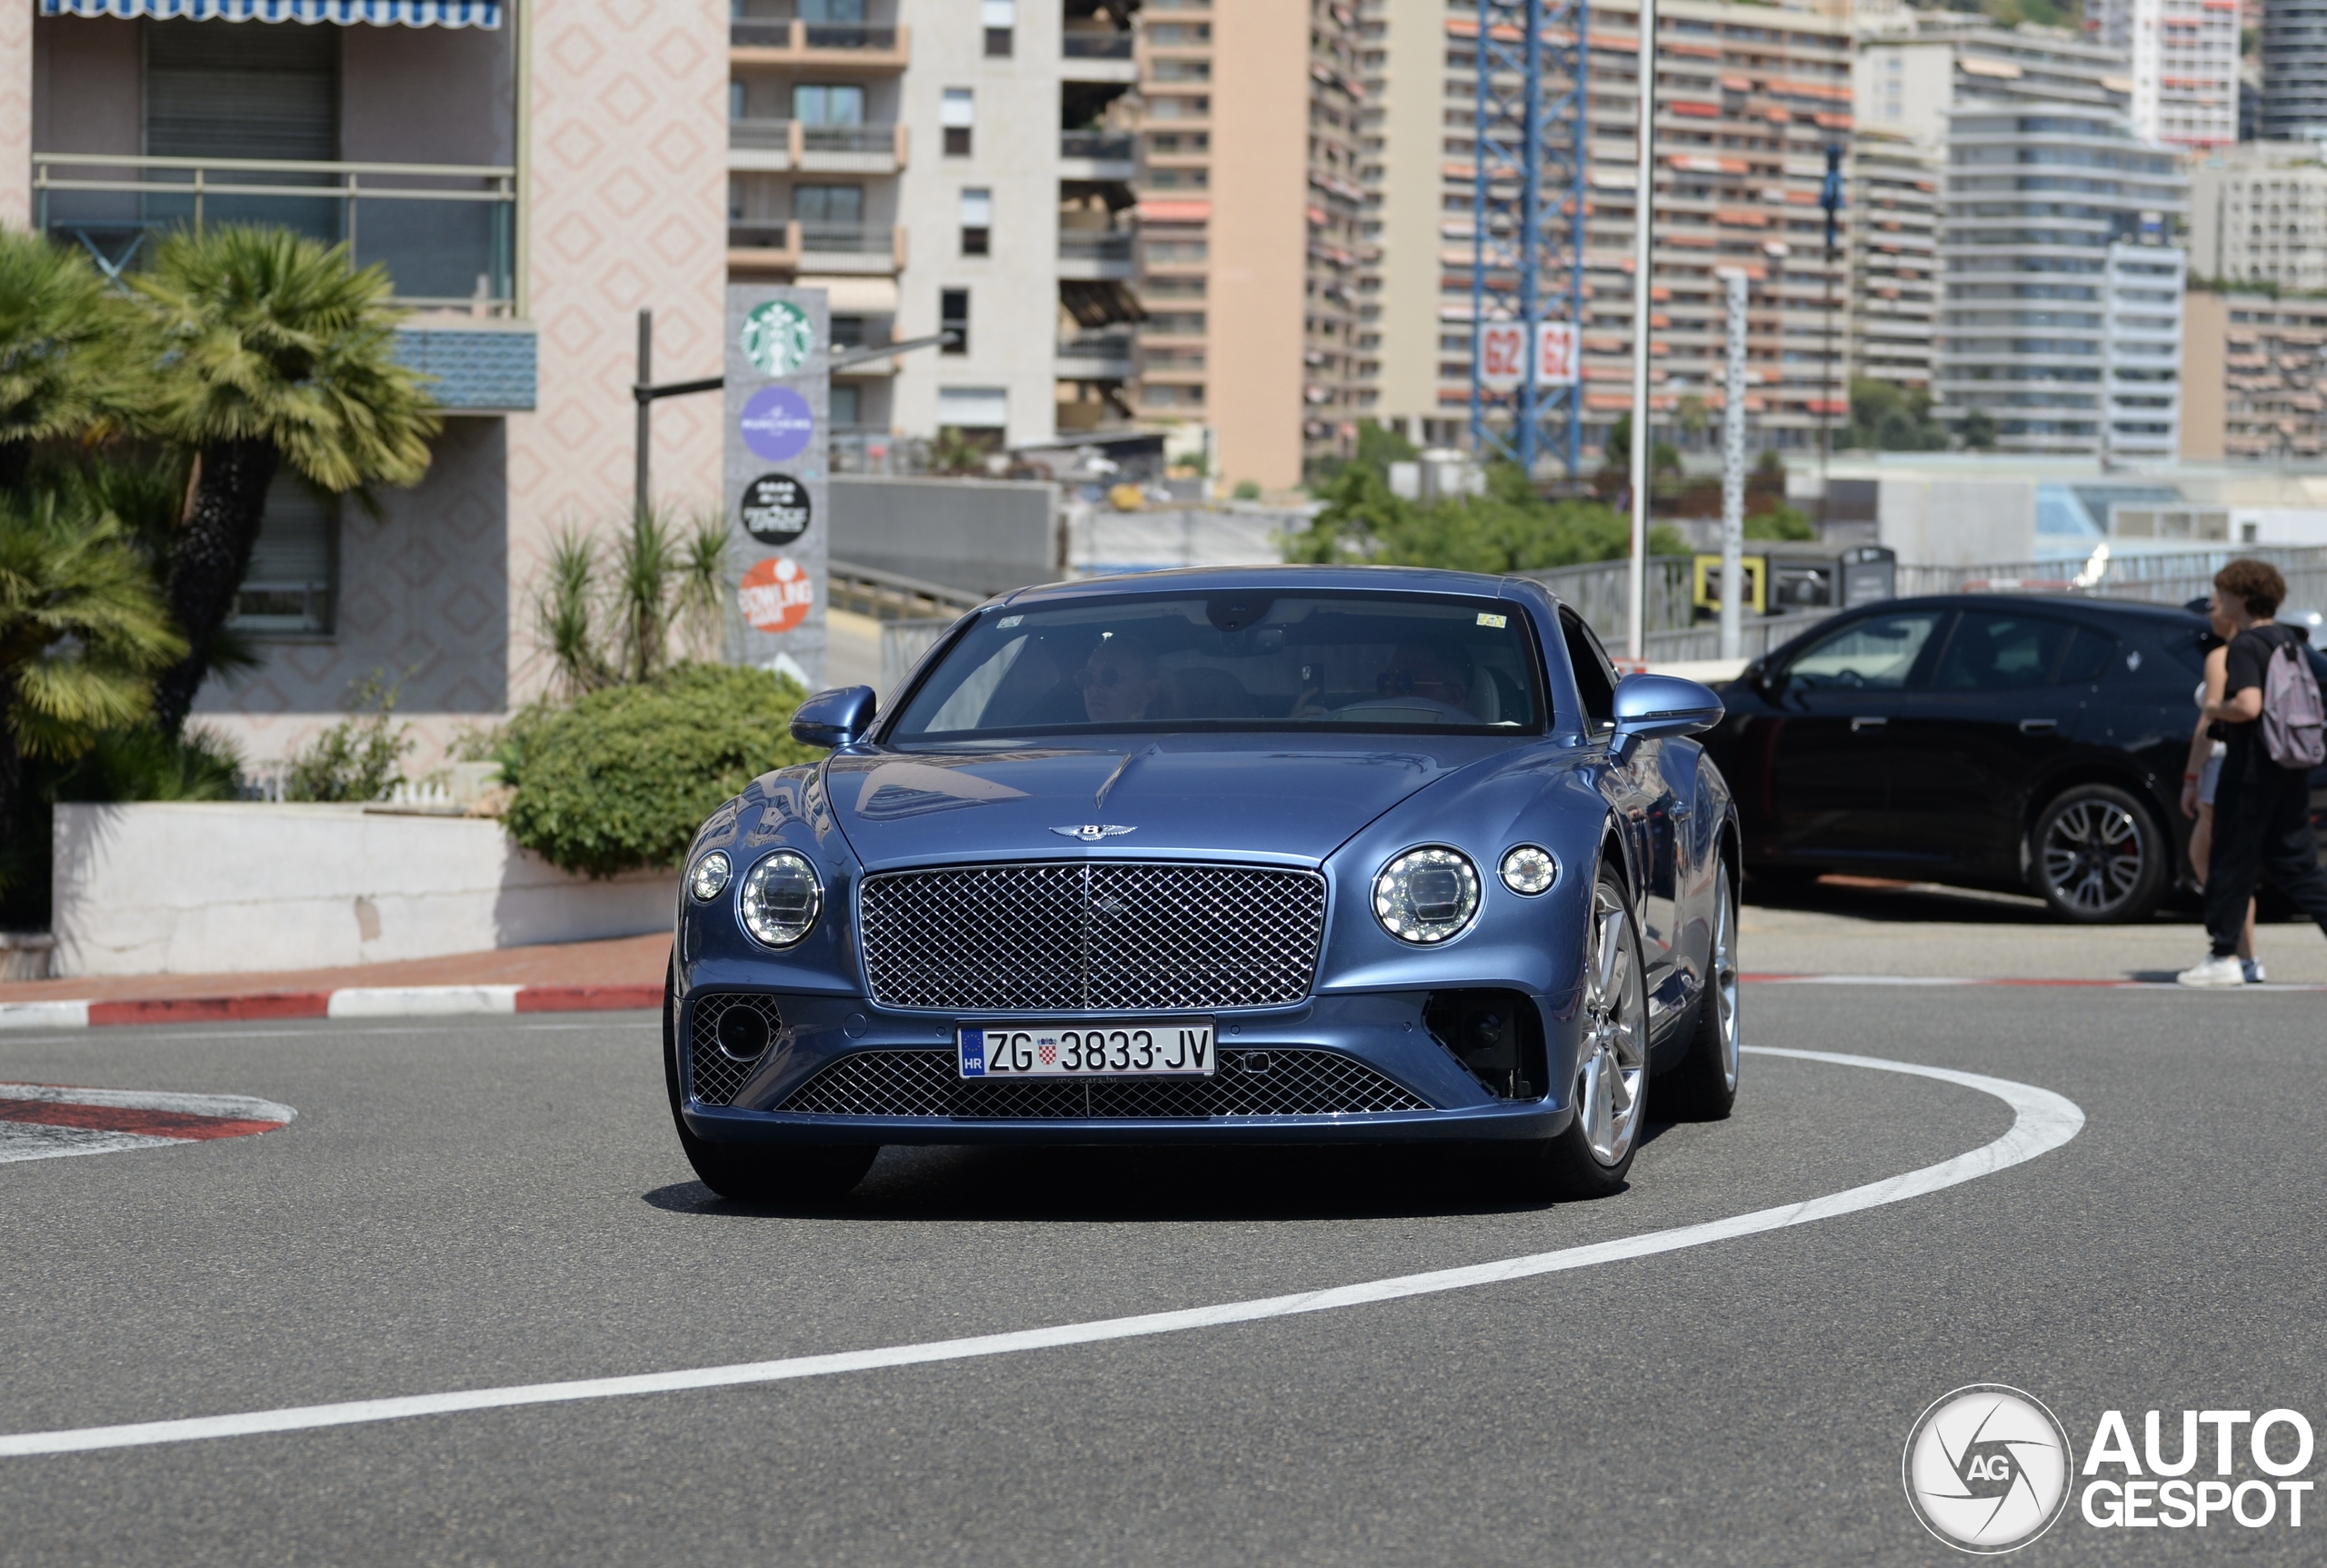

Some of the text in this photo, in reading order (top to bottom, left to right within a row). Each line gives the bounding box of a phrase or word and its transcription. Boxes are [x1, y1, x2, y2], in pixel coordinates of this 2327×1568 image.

[987, 1032, 1033, 1071] ZG
[964, 1057, 983, 1070] HR
[1056, 1076, 1119, 1084] mc-cars.hr
